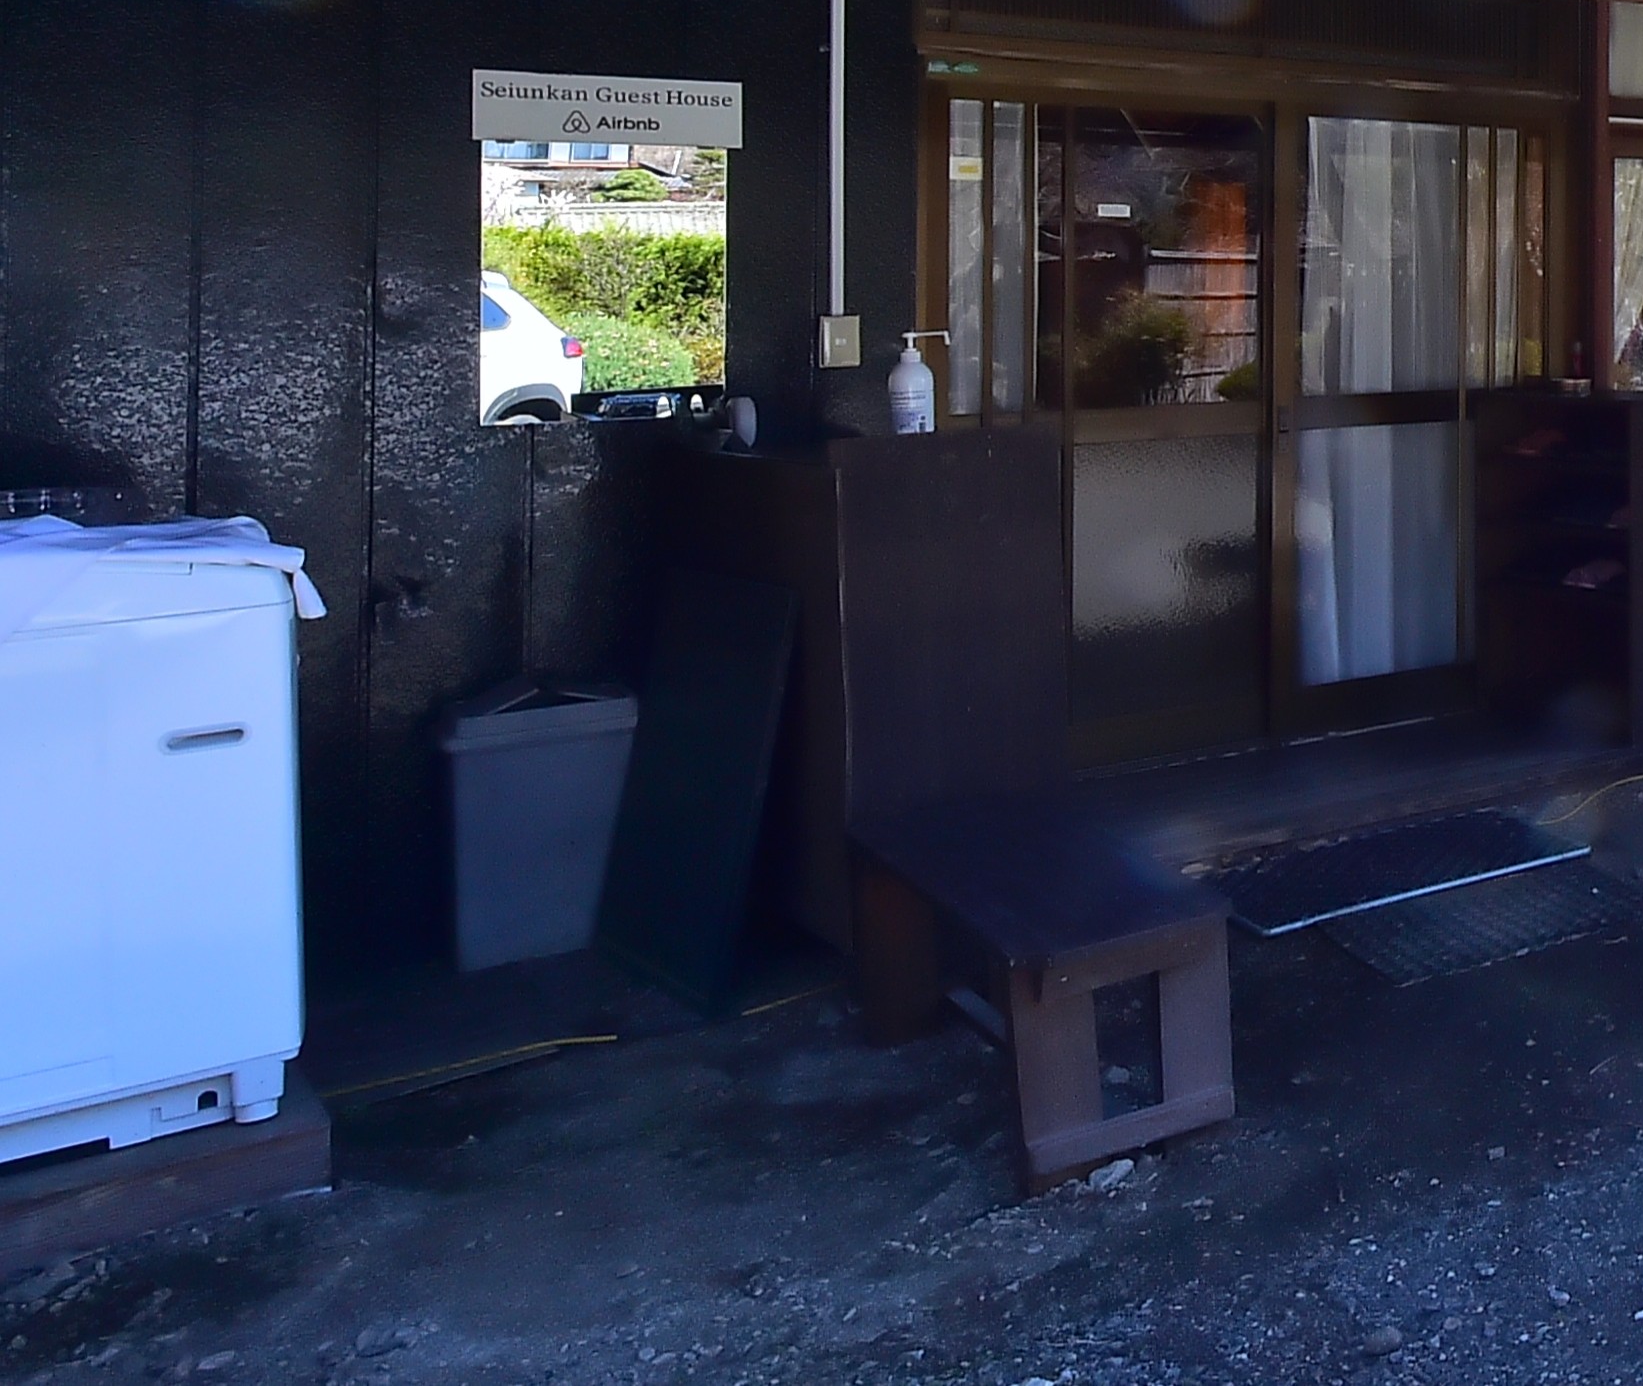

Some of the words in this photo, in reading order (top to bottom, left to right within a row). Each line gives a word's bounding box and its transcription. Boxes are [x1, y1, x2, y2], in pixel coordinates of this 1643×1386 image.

[480, 81, 588, 102] Seiunkan
[595, 87, 661, 105] Guest
[665, 90, 733, 107] House
[596, 116, 660, 131] Airbnb
